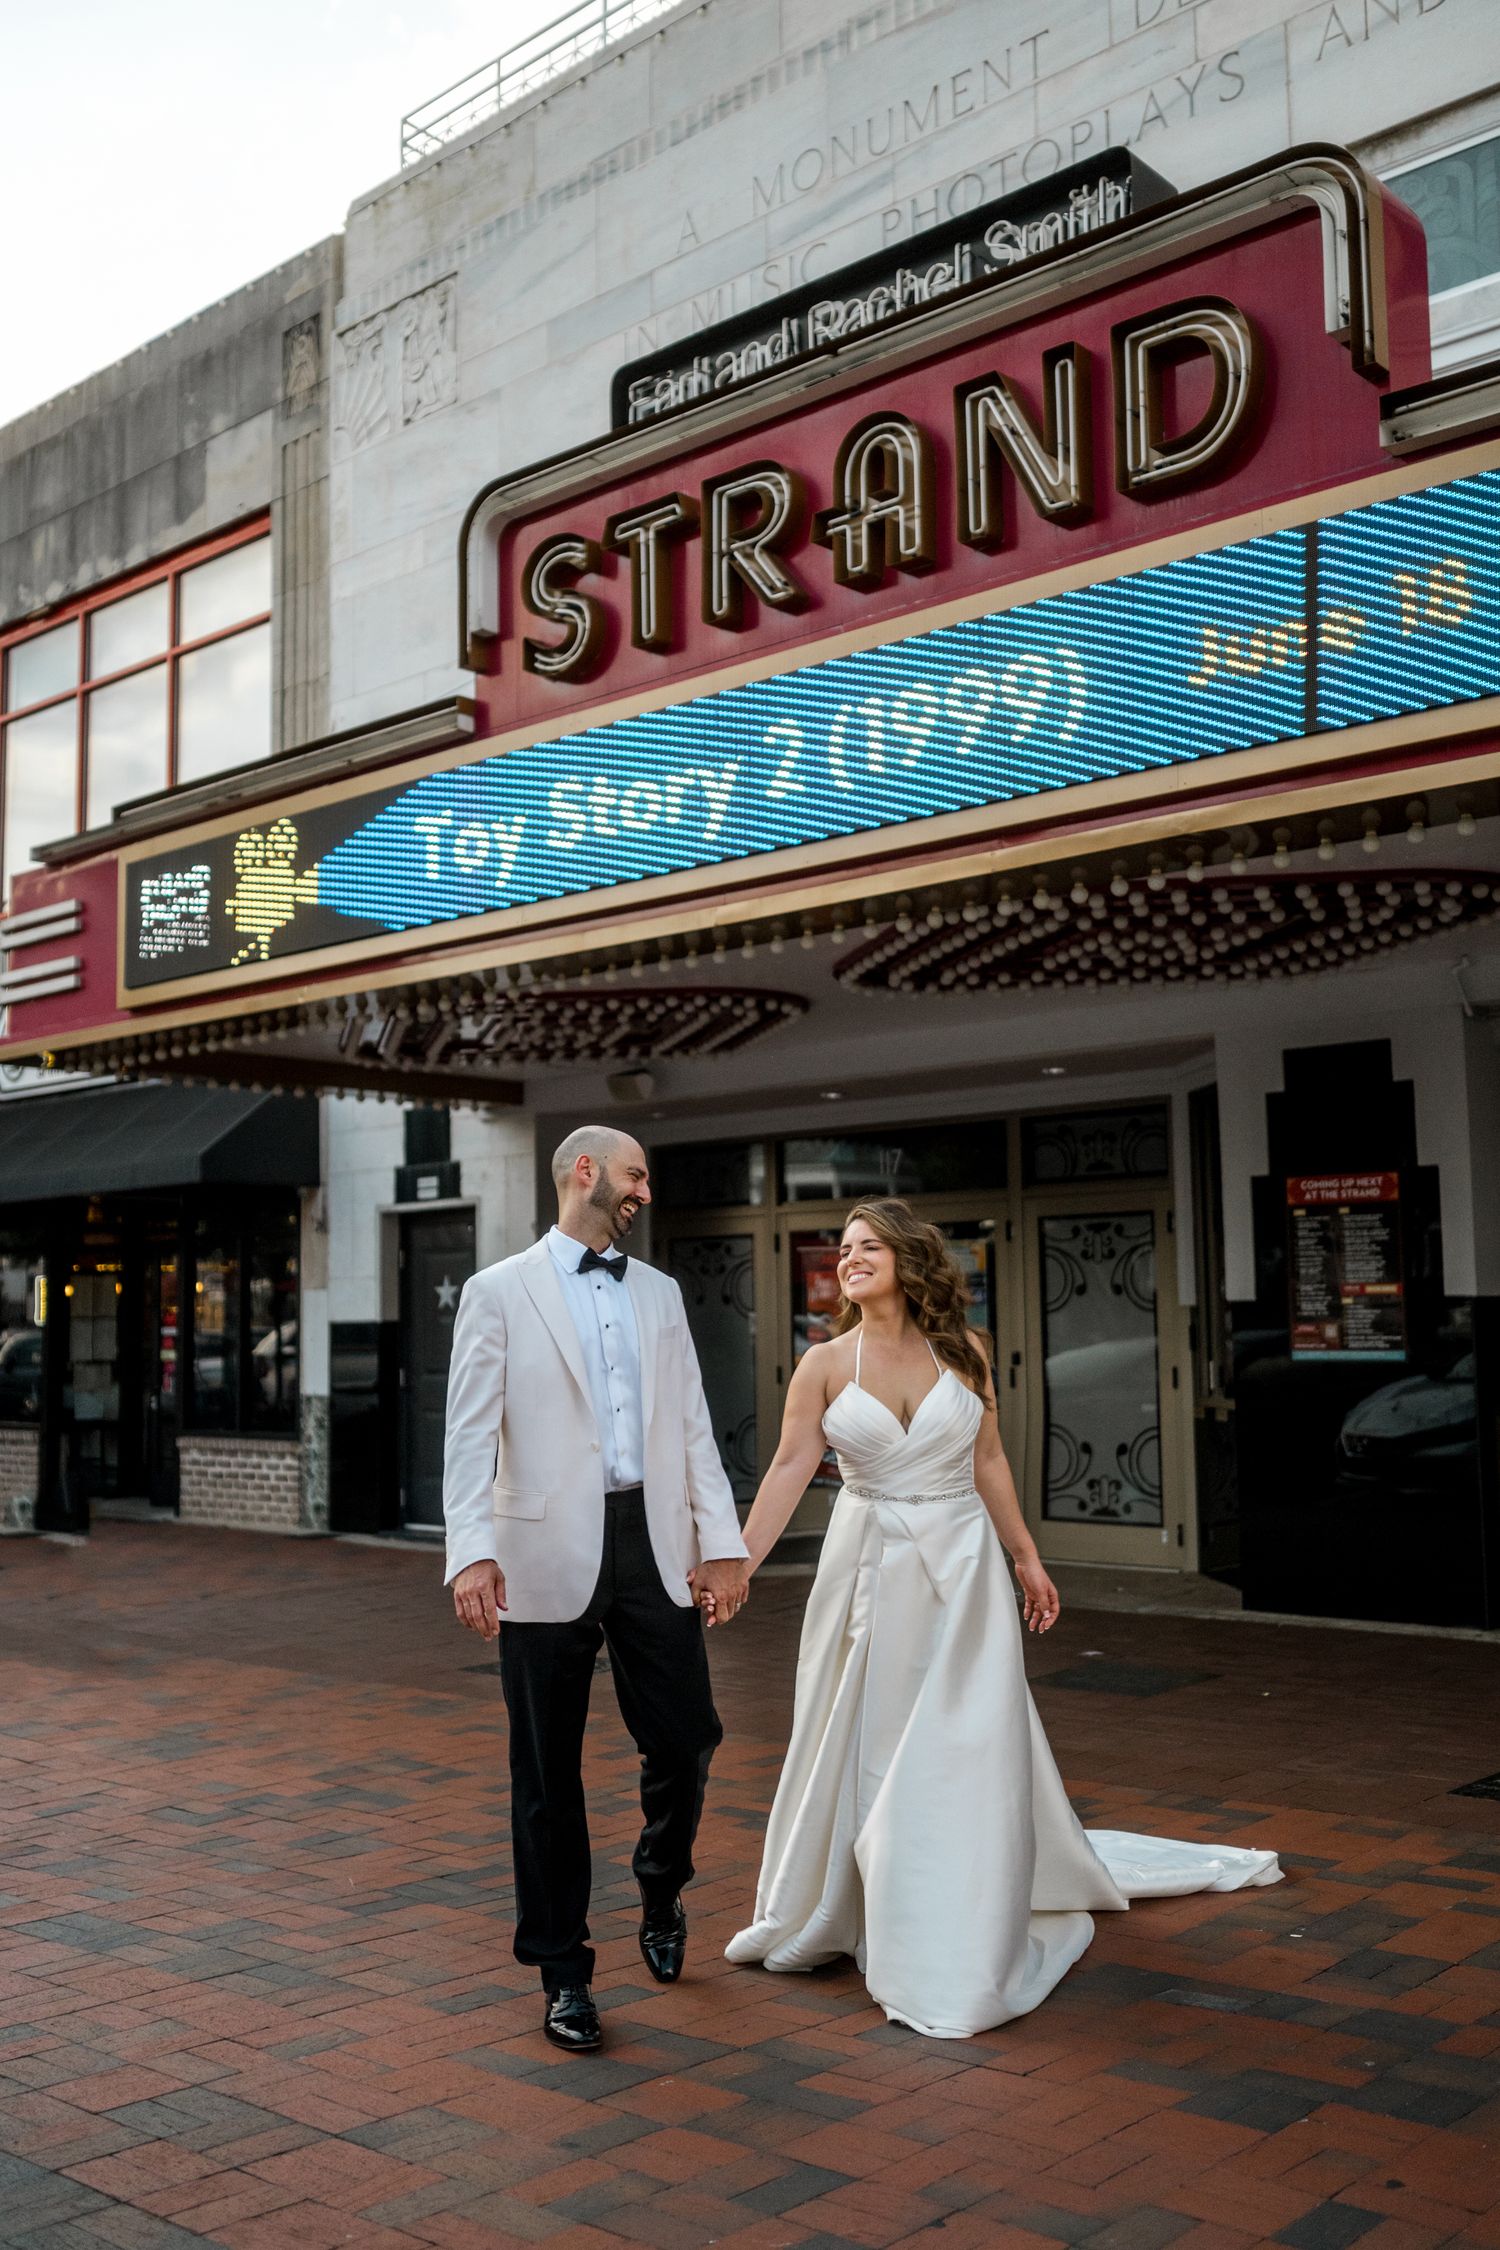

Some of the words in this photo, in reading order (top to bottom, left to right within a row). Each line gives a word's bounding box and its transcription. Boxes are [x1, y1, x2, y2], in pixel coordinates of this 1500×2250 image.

[677, 208, 701, 254] A
[751, 28, 1051, 217] MONUMENT
[690, 242, 827, 331] MUSIC
[880, 51, 1245, 247] PHOTOPLAYS
[1315, 0, 1447, 61] AN
[628, 355, 711, 424] Earl
[714, 317, 797, 391] and
[808, 242, 971, 350] Rachel
[983, 176, 1131, 275] Smith
[521, 296, 1262, 683] STRAND
[1187, 605, 1367, 686] June
[414, 809, 526, 887] Toy
[546, 755, 744, 848] Story
[764, 717, 804, 799] 2
[828, 647, 1088, 790] (1999)
[879, 1148, 903, 1175] 117
[1300, 1179, 1340, 1190] COMING
[1341, 1178, 1355, 1188] UP
[1356, 1176, 1384, 1186] NEXT
[1303, 1190, 1317, 1200] AT
[1320, 1189, 1339, 1199] THE
[1341, 1187, 1381, 1198] STRAND
